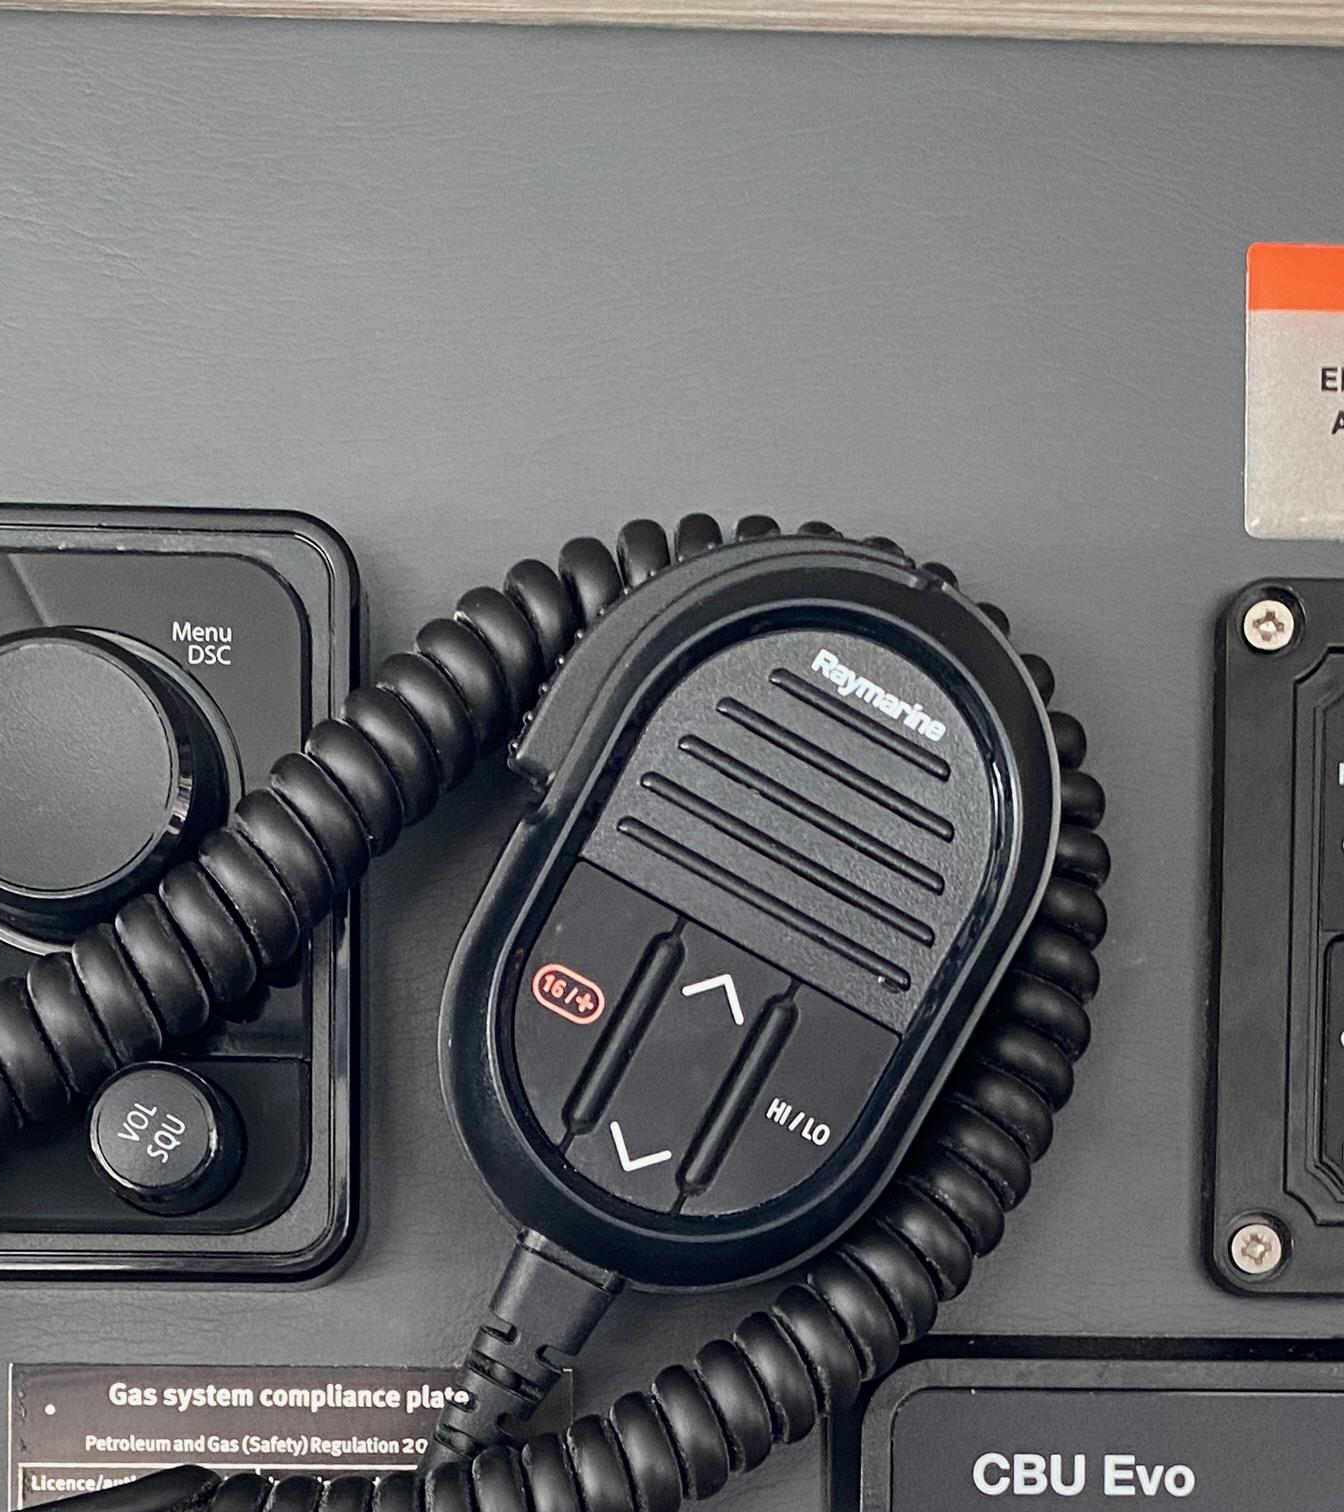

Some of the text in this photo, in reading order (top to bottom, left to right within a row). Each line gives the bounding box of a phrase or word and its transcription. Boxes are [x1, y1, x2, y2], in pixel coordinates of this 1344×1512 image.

[172, 621, 232, 643] Menu
[188, 644, 232, 665] DSC
[810, 649, 948, 743] Raymarine
[116, 1102, 158, 1142] VOL
[146, 1113, 186, 1164] SQU
[108, 1382, 158, 1406] Gas
[162, 1384, 254, 1413] system
[259, 1383, 401, 1413] compliance
[85, 1434, 400, 1457] Petroleum and Gas (Safety) Regulation
[972, 1452, 1196, 1497] CBU Evo
